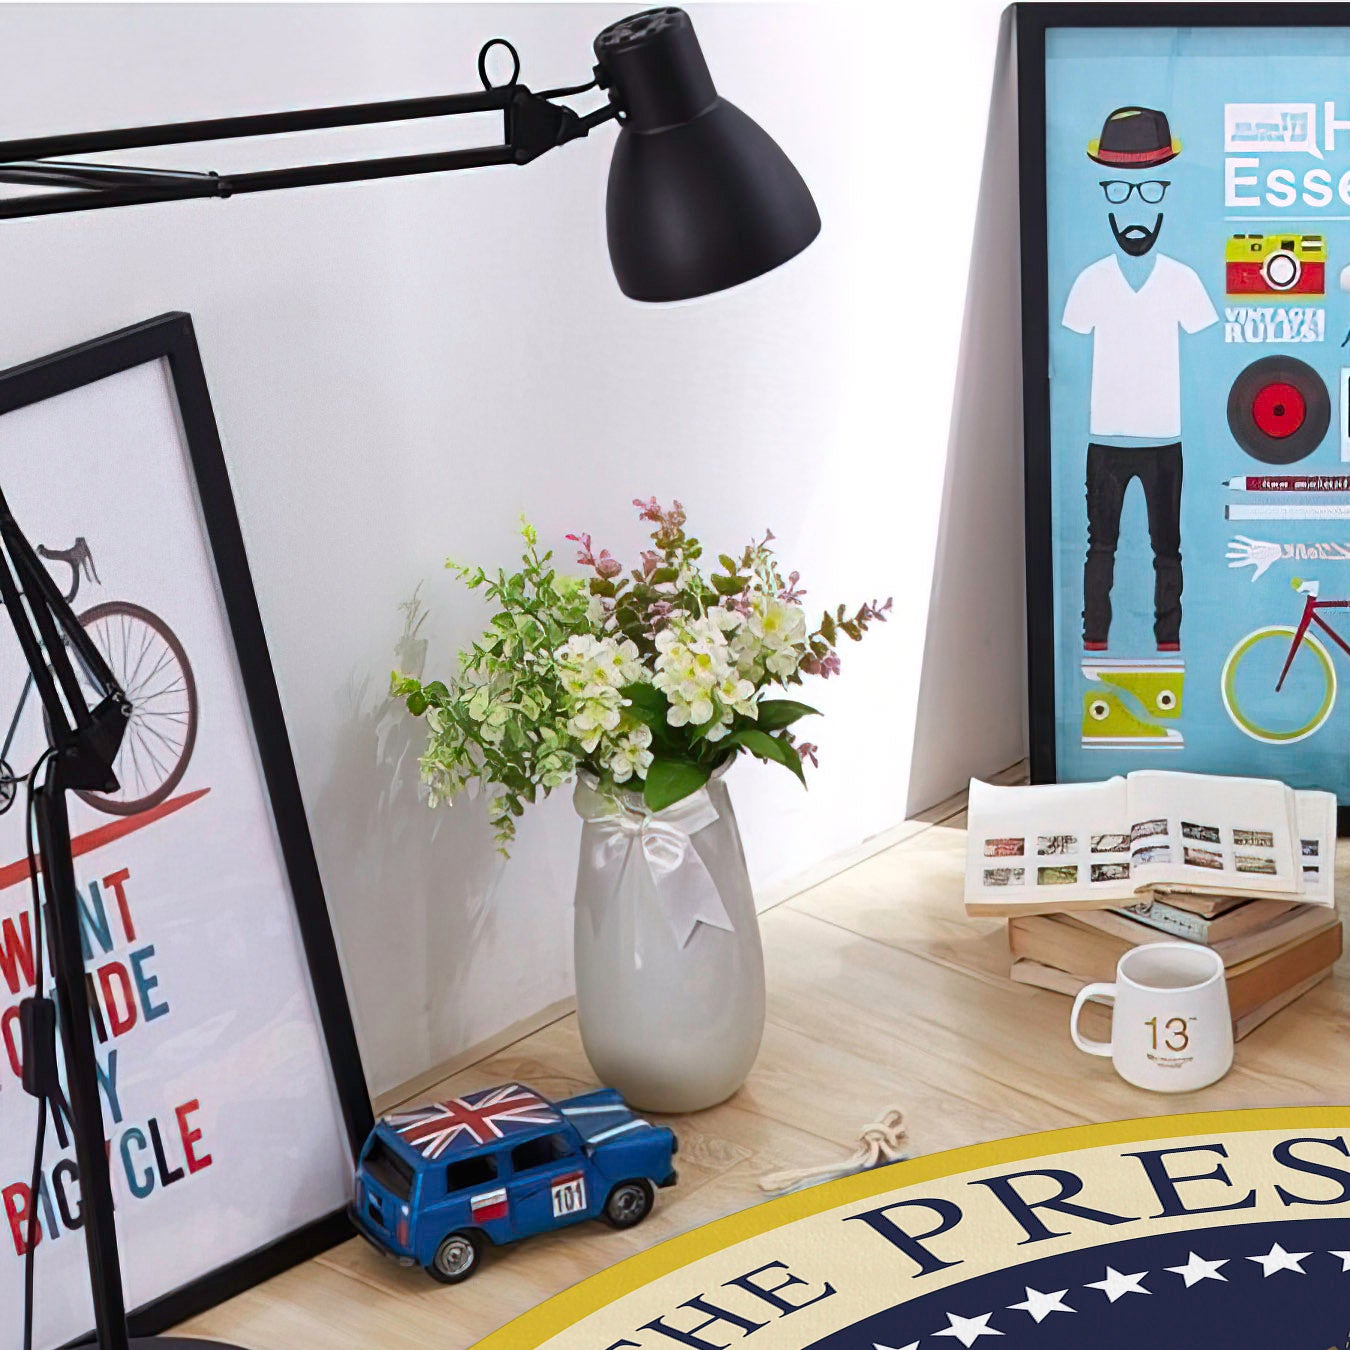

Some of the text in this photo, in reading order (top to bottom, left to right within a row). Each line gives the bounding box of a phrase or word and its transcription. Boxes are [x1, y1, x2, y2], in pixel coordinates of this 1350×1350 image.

[0, 867, 136, 995] WNT
[1144, 1016, 1190, 1052] 13
[1, 1098, 213, 1256] BICCLE
